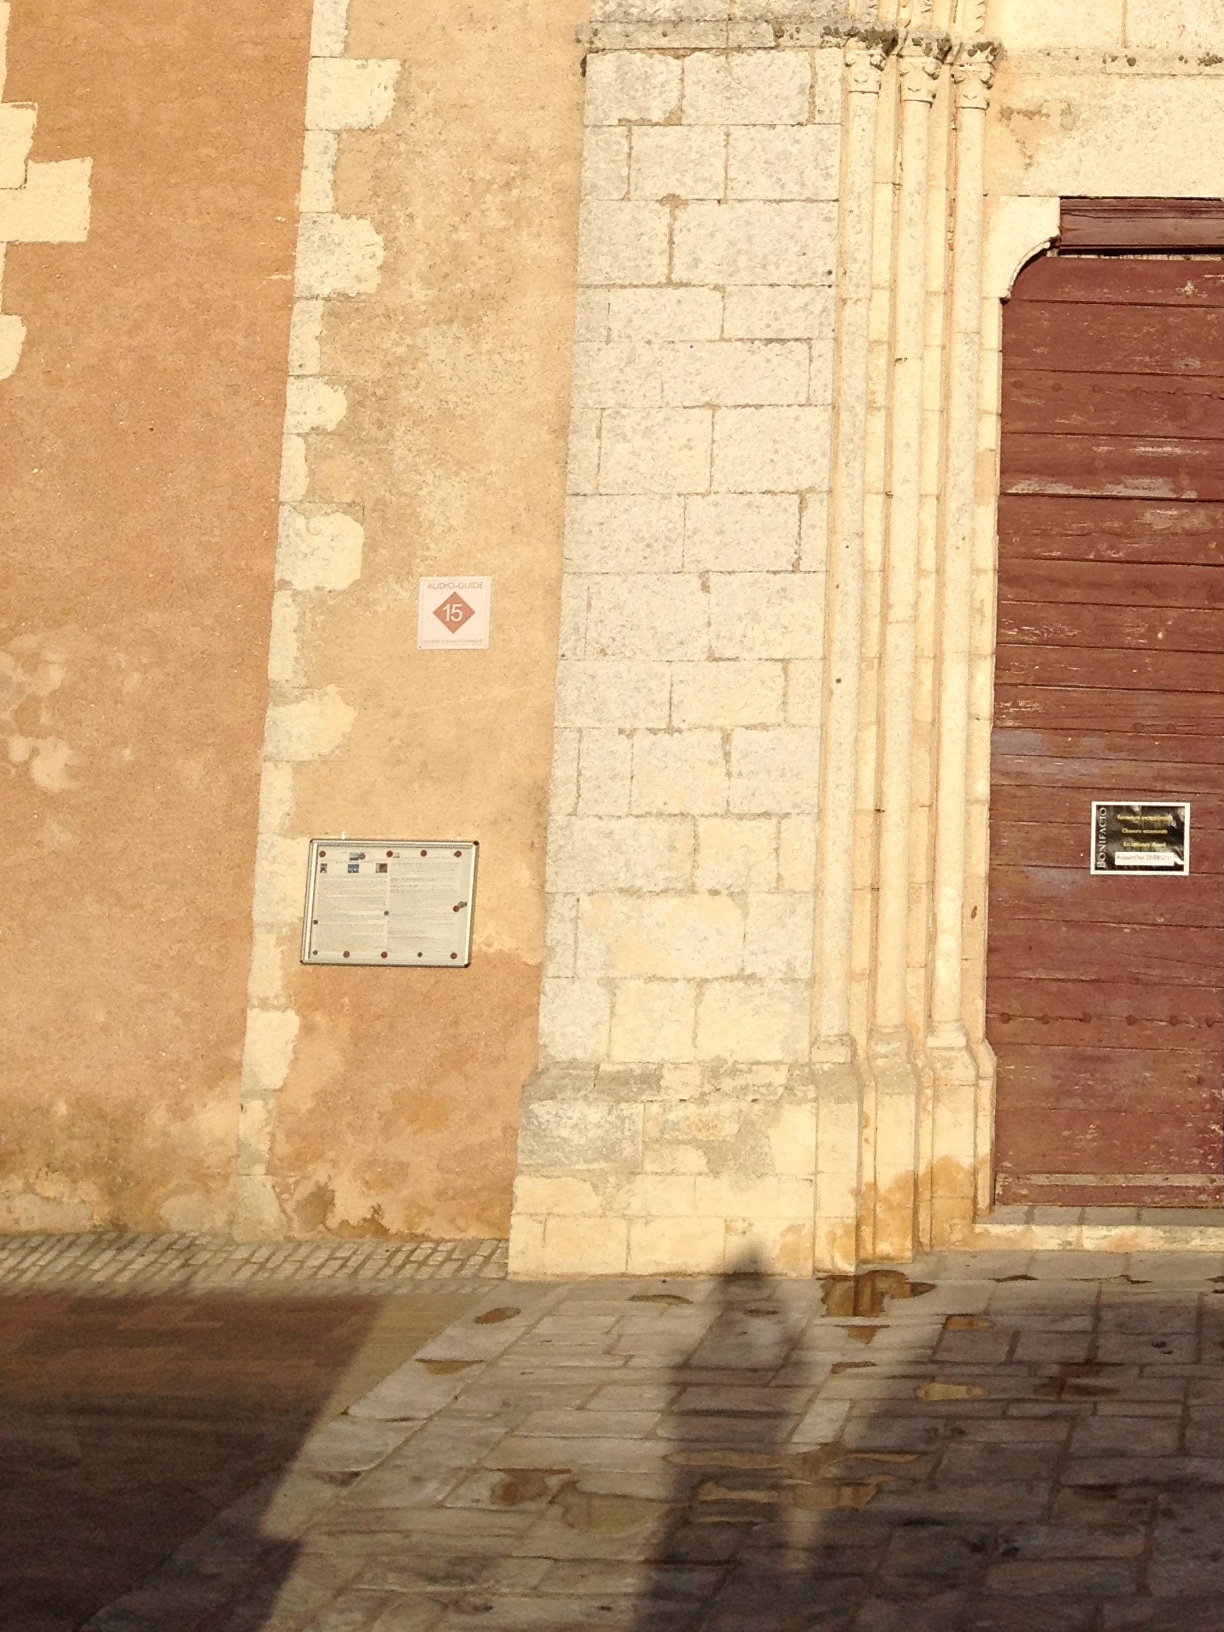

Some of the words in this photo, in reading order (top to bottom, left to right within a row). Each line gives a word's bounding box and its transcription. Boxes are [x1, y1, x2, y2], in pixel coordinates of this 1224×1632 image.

[427, 582, 483, 590] AUDIO-GUIDE
[442, 603, 463, 622] 15
[1097, 807, 1107, 868] BONIFACIO
